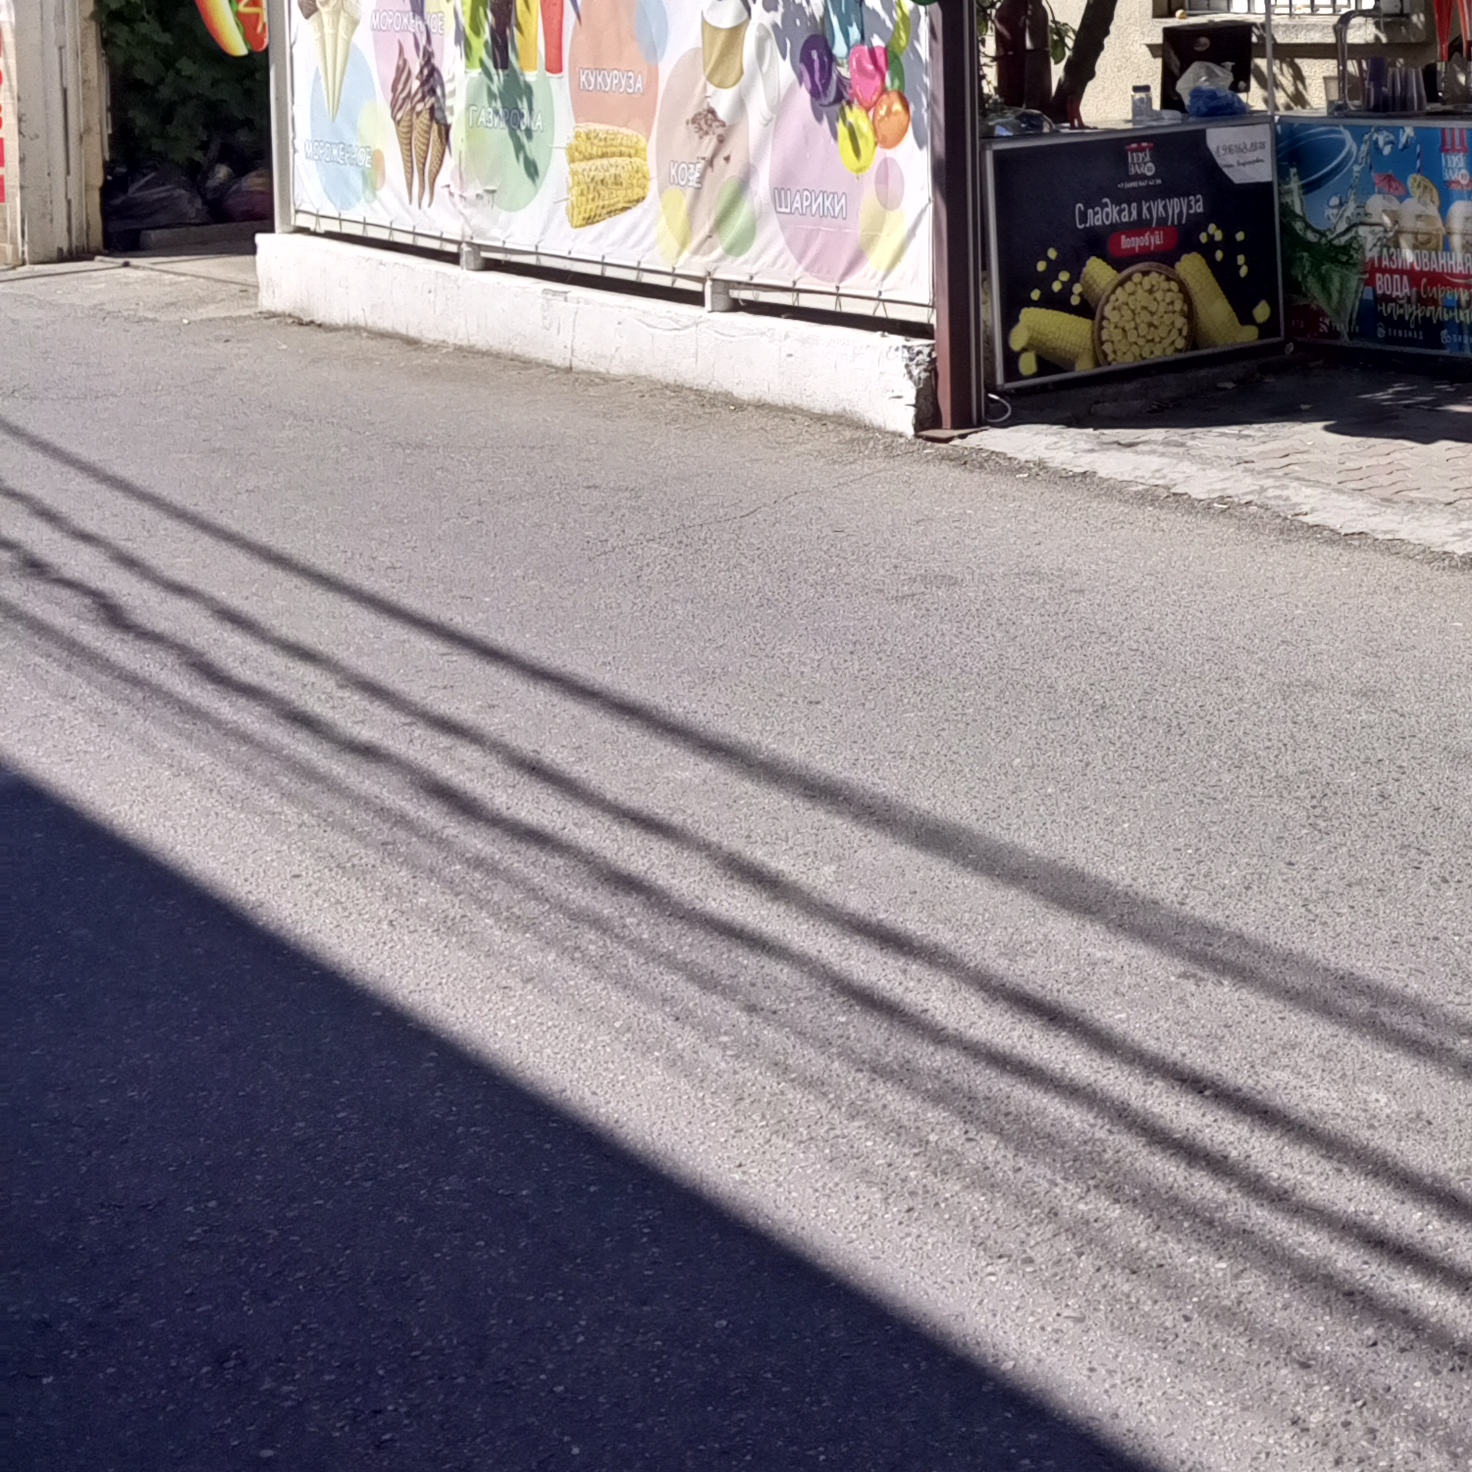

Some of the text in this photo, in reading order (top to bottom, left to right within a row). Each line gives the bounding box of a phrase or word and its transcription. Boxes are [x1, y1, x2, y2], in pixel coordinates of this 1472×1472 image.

[579, 67, 643, 93] КУКУРУЗА
[774, 188, 847, 220] ШАРИКИ
[1075, 194, 1204, 230] Сладкая кукуруза
[1120, 230, 1164, 253] Попробуй!
[1375, 272, 1411, 298] ВОДА
